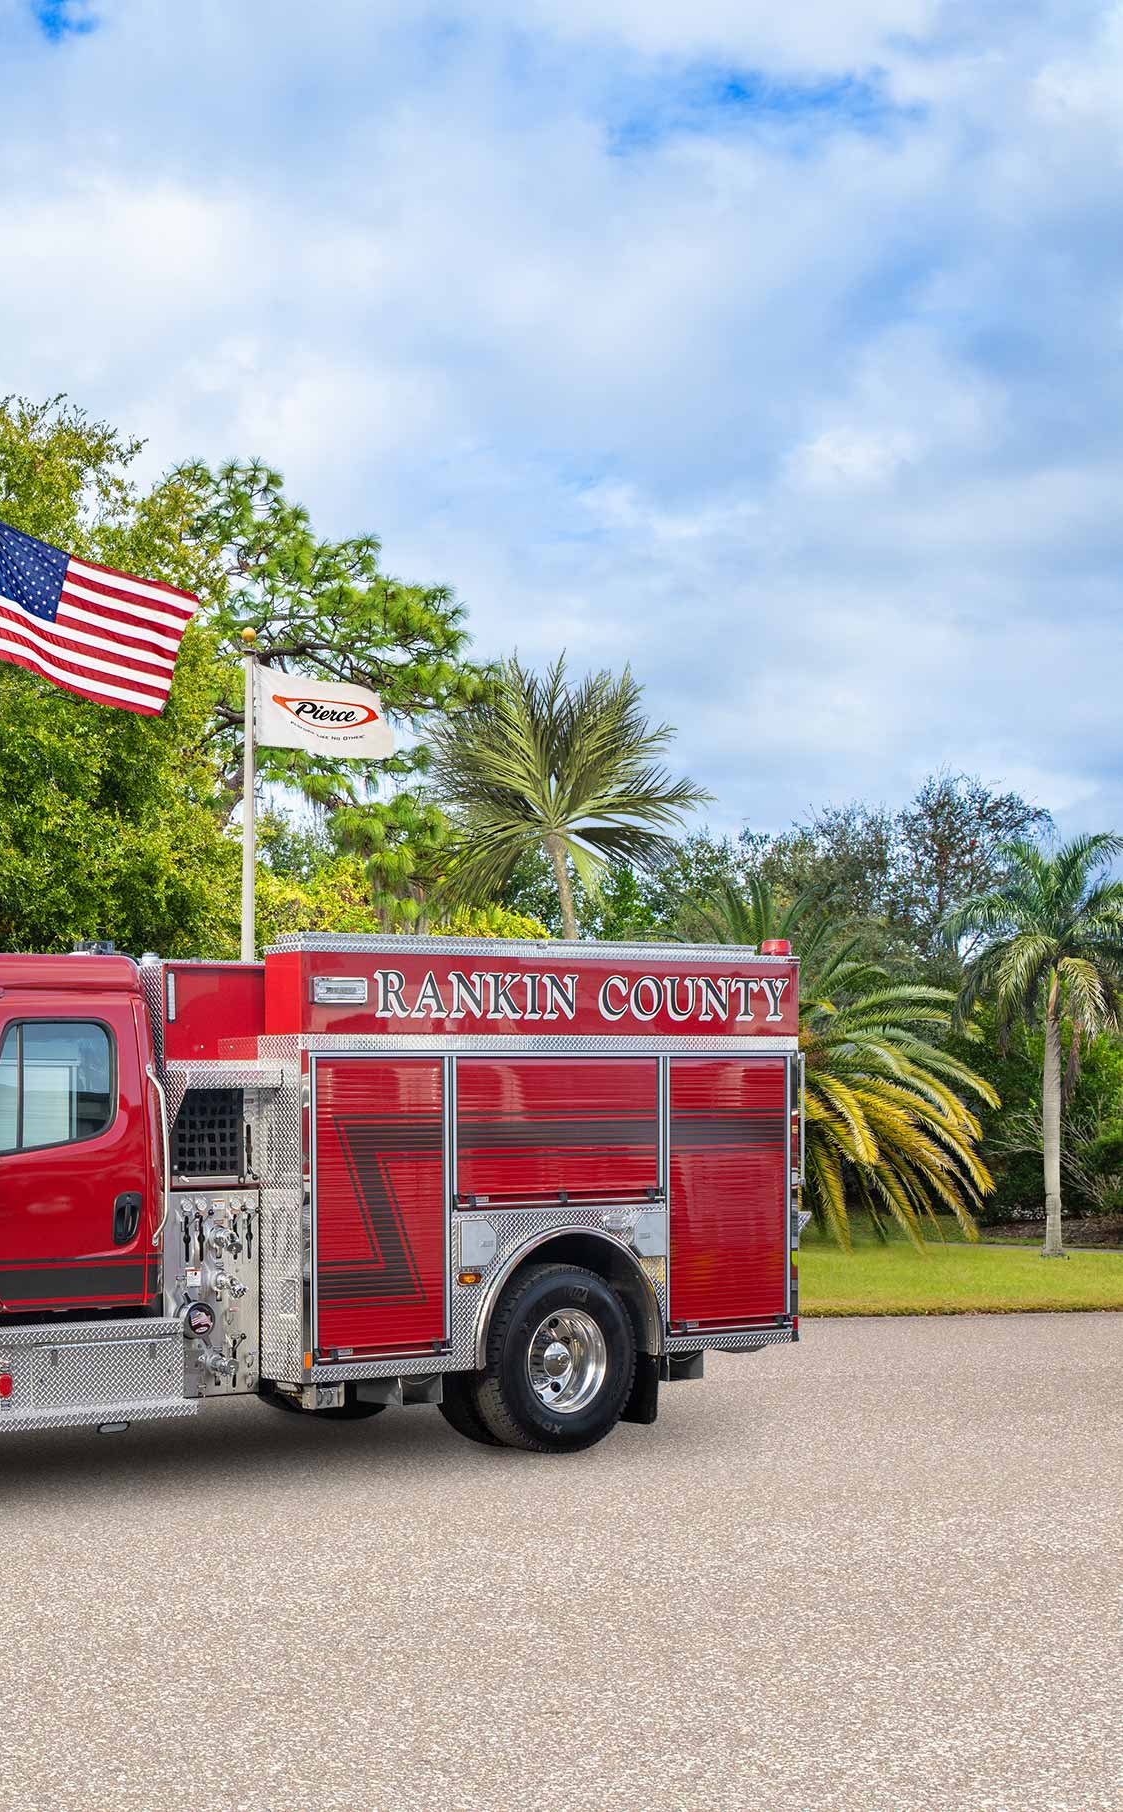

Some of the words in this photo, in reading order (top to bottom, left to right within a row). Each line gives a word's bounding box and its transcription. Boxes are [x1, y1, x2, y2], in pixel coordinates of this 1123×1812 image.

[295, 701, 356, 722] Pierce
[375, 970, 578, 1019] RANKIN
[598, 976, 790, 1022] COUNTY
